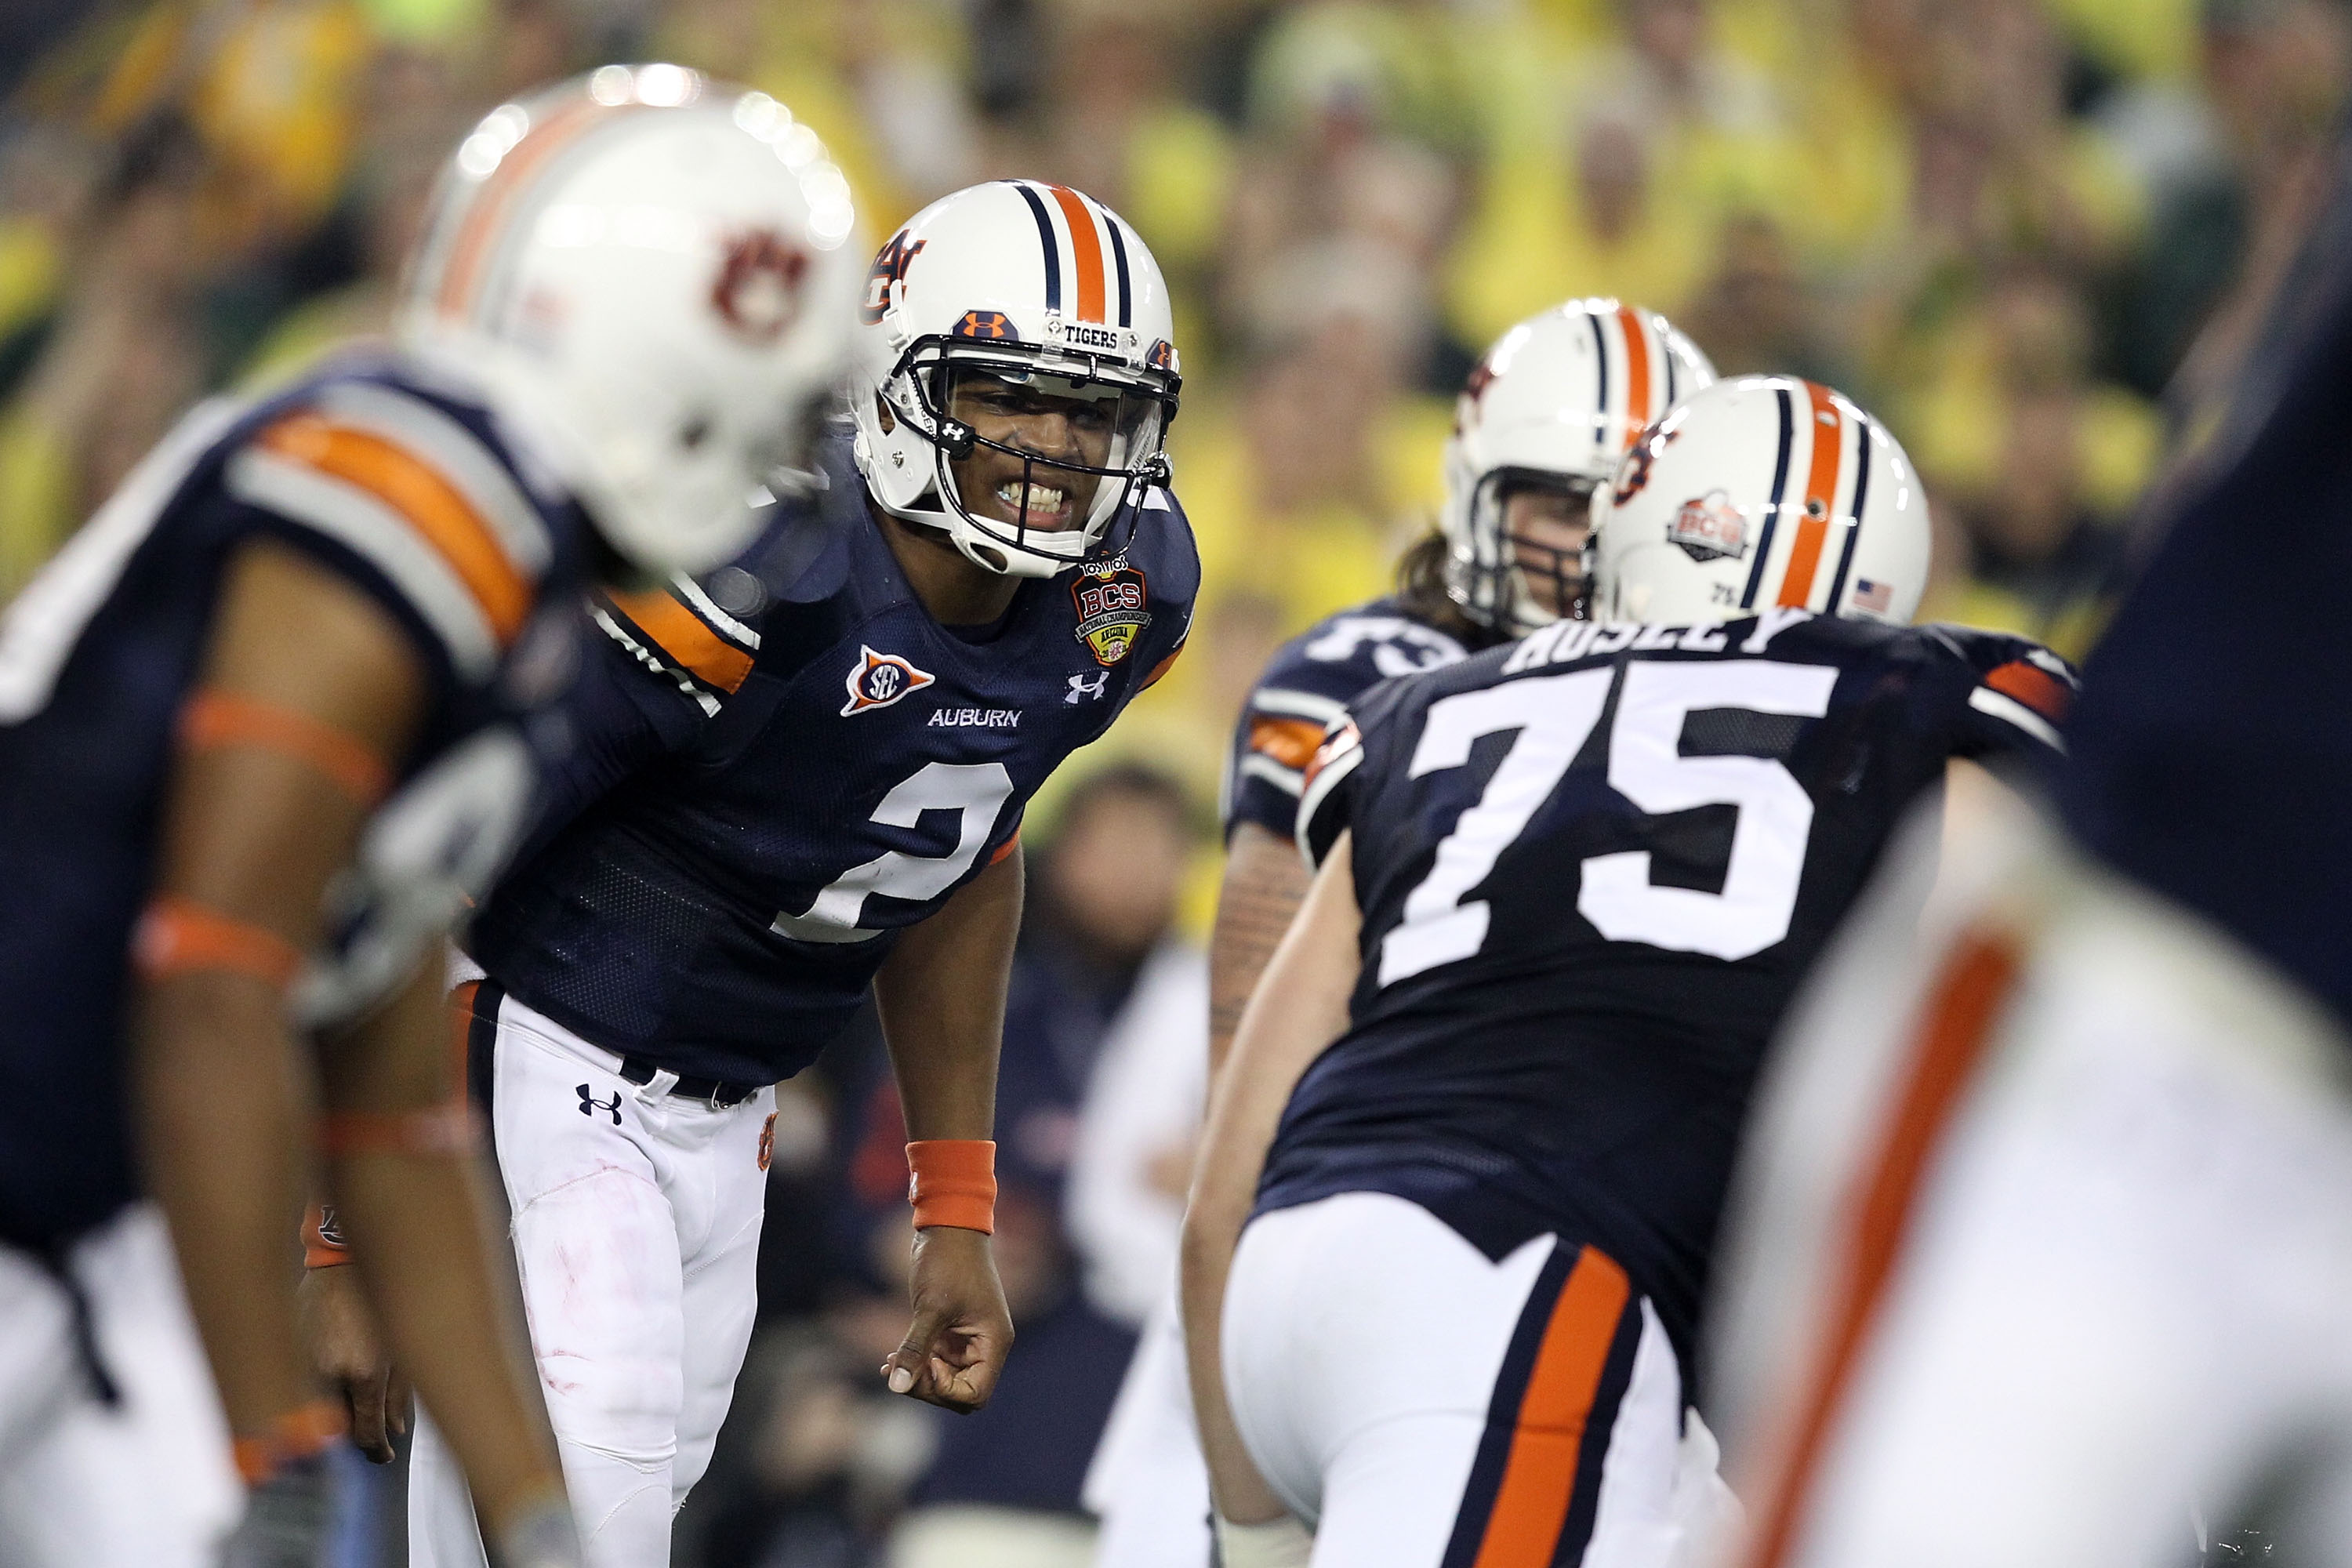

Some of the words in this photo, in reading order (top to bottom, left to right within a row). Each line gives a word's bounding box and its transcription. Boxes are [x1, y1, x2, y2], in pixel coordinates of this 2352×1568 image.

[1065, 325, 1117, 349] TIGERS
[1081, 583, 1141, 618] BCS
[1102, 626, 1127, 642] ARIZONA
[869, 665, 900, 699] SEC
[927, 709, 1022, 728] AUBURN
[1378, 660, 1838, 987] 75
[770, 762, 1014, 942] 2
